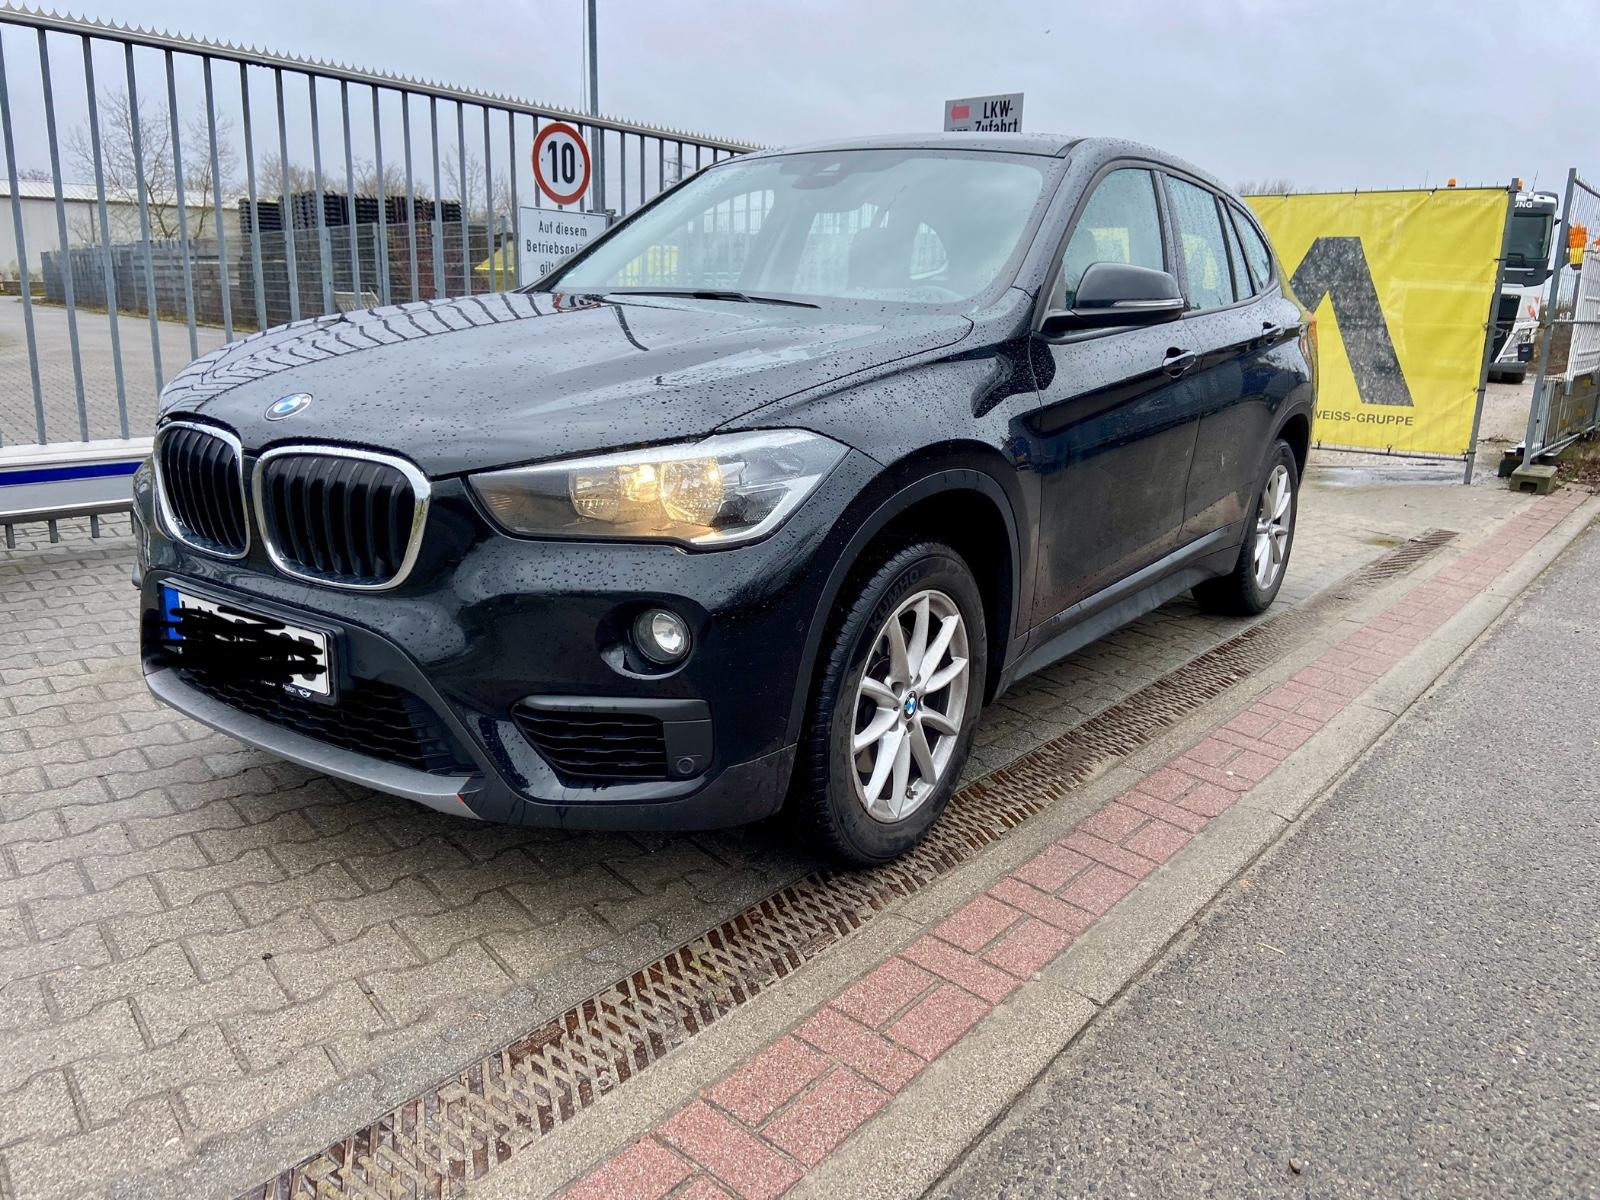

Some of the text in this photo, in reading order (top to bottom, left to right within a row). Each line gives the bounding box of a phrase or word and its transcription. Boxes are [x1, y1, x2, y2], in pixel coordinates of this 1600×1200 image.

[984, 100, 1013, 119] LKW-
[975, 118, 1018, 132] Zufahrt
[547, 140, 576, 185] 10
[539, 220, 587, 237] Auf diesem
